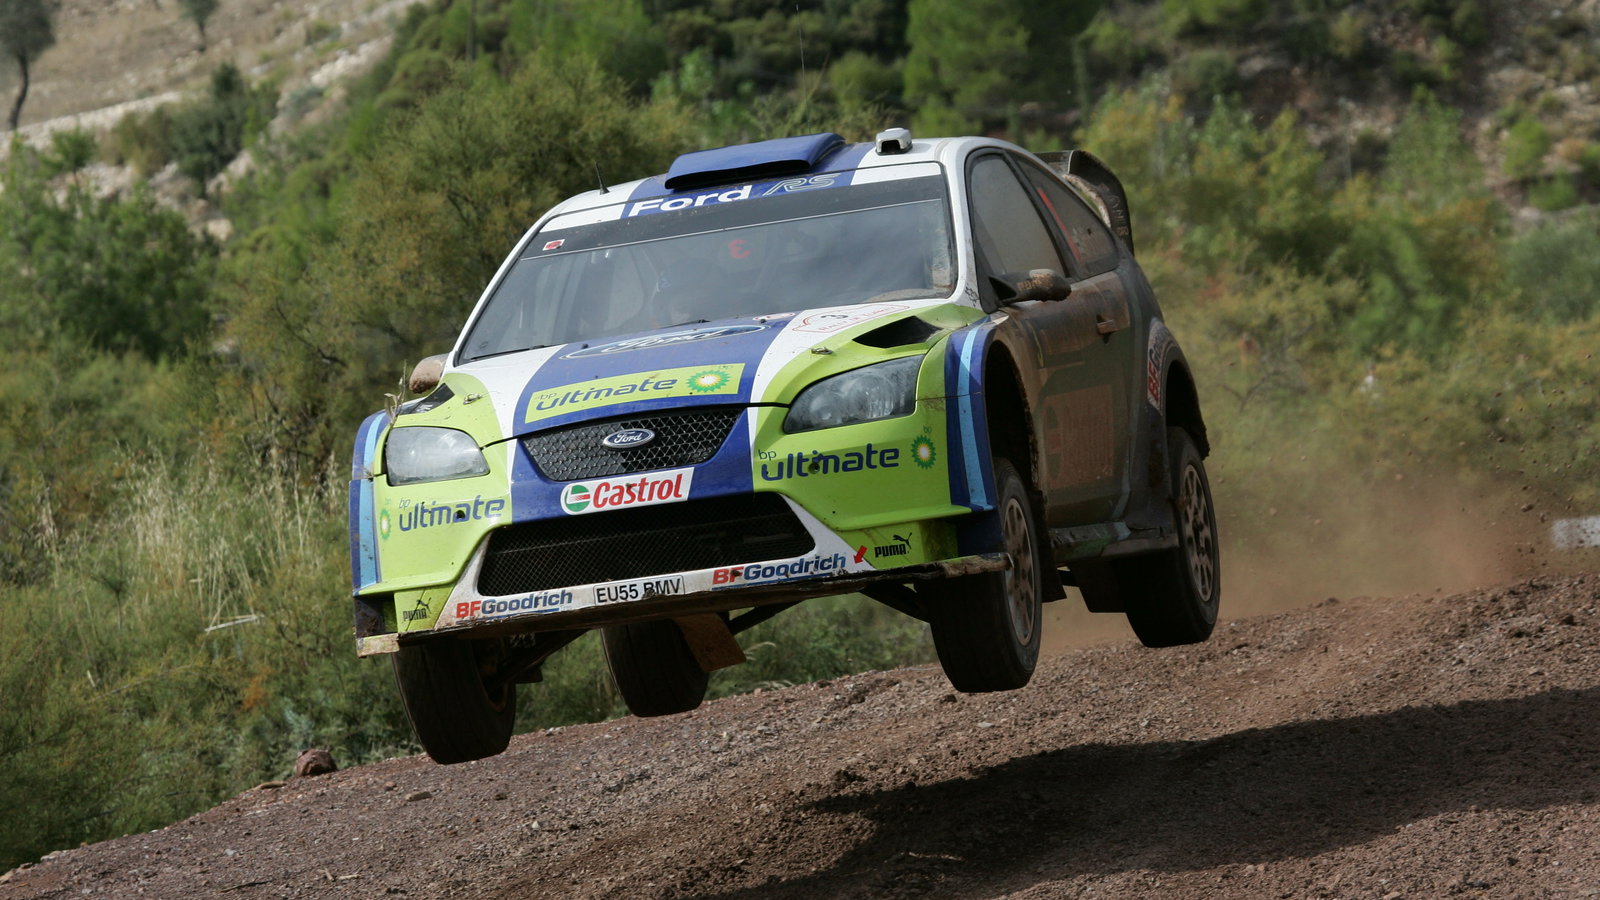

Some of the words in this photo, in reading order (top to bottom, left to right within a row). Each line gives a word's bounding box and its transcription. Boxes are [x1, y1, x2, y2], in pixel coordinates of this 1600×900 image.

[628, 185, 752, 217] Ford
[762, 173, 840, 196] RS
[535, 378, 678, 412] ultimate
[614, 431, 643, 444] Ford
[758, 449, 777, 461] bp
[761, 443, 899, 481] ultimate
[593, 473, 683, 508] Castrol
[399, 495, 505, 531] ultimate
[874, 543, 907, 558] PUMA
[712, 553, 846, 585] BFGoodrich
[456, 590, 573, 618] BFGoodrich
[596, 584, 639, 603] EU55
[402, 608, 428, 622] PUMA
